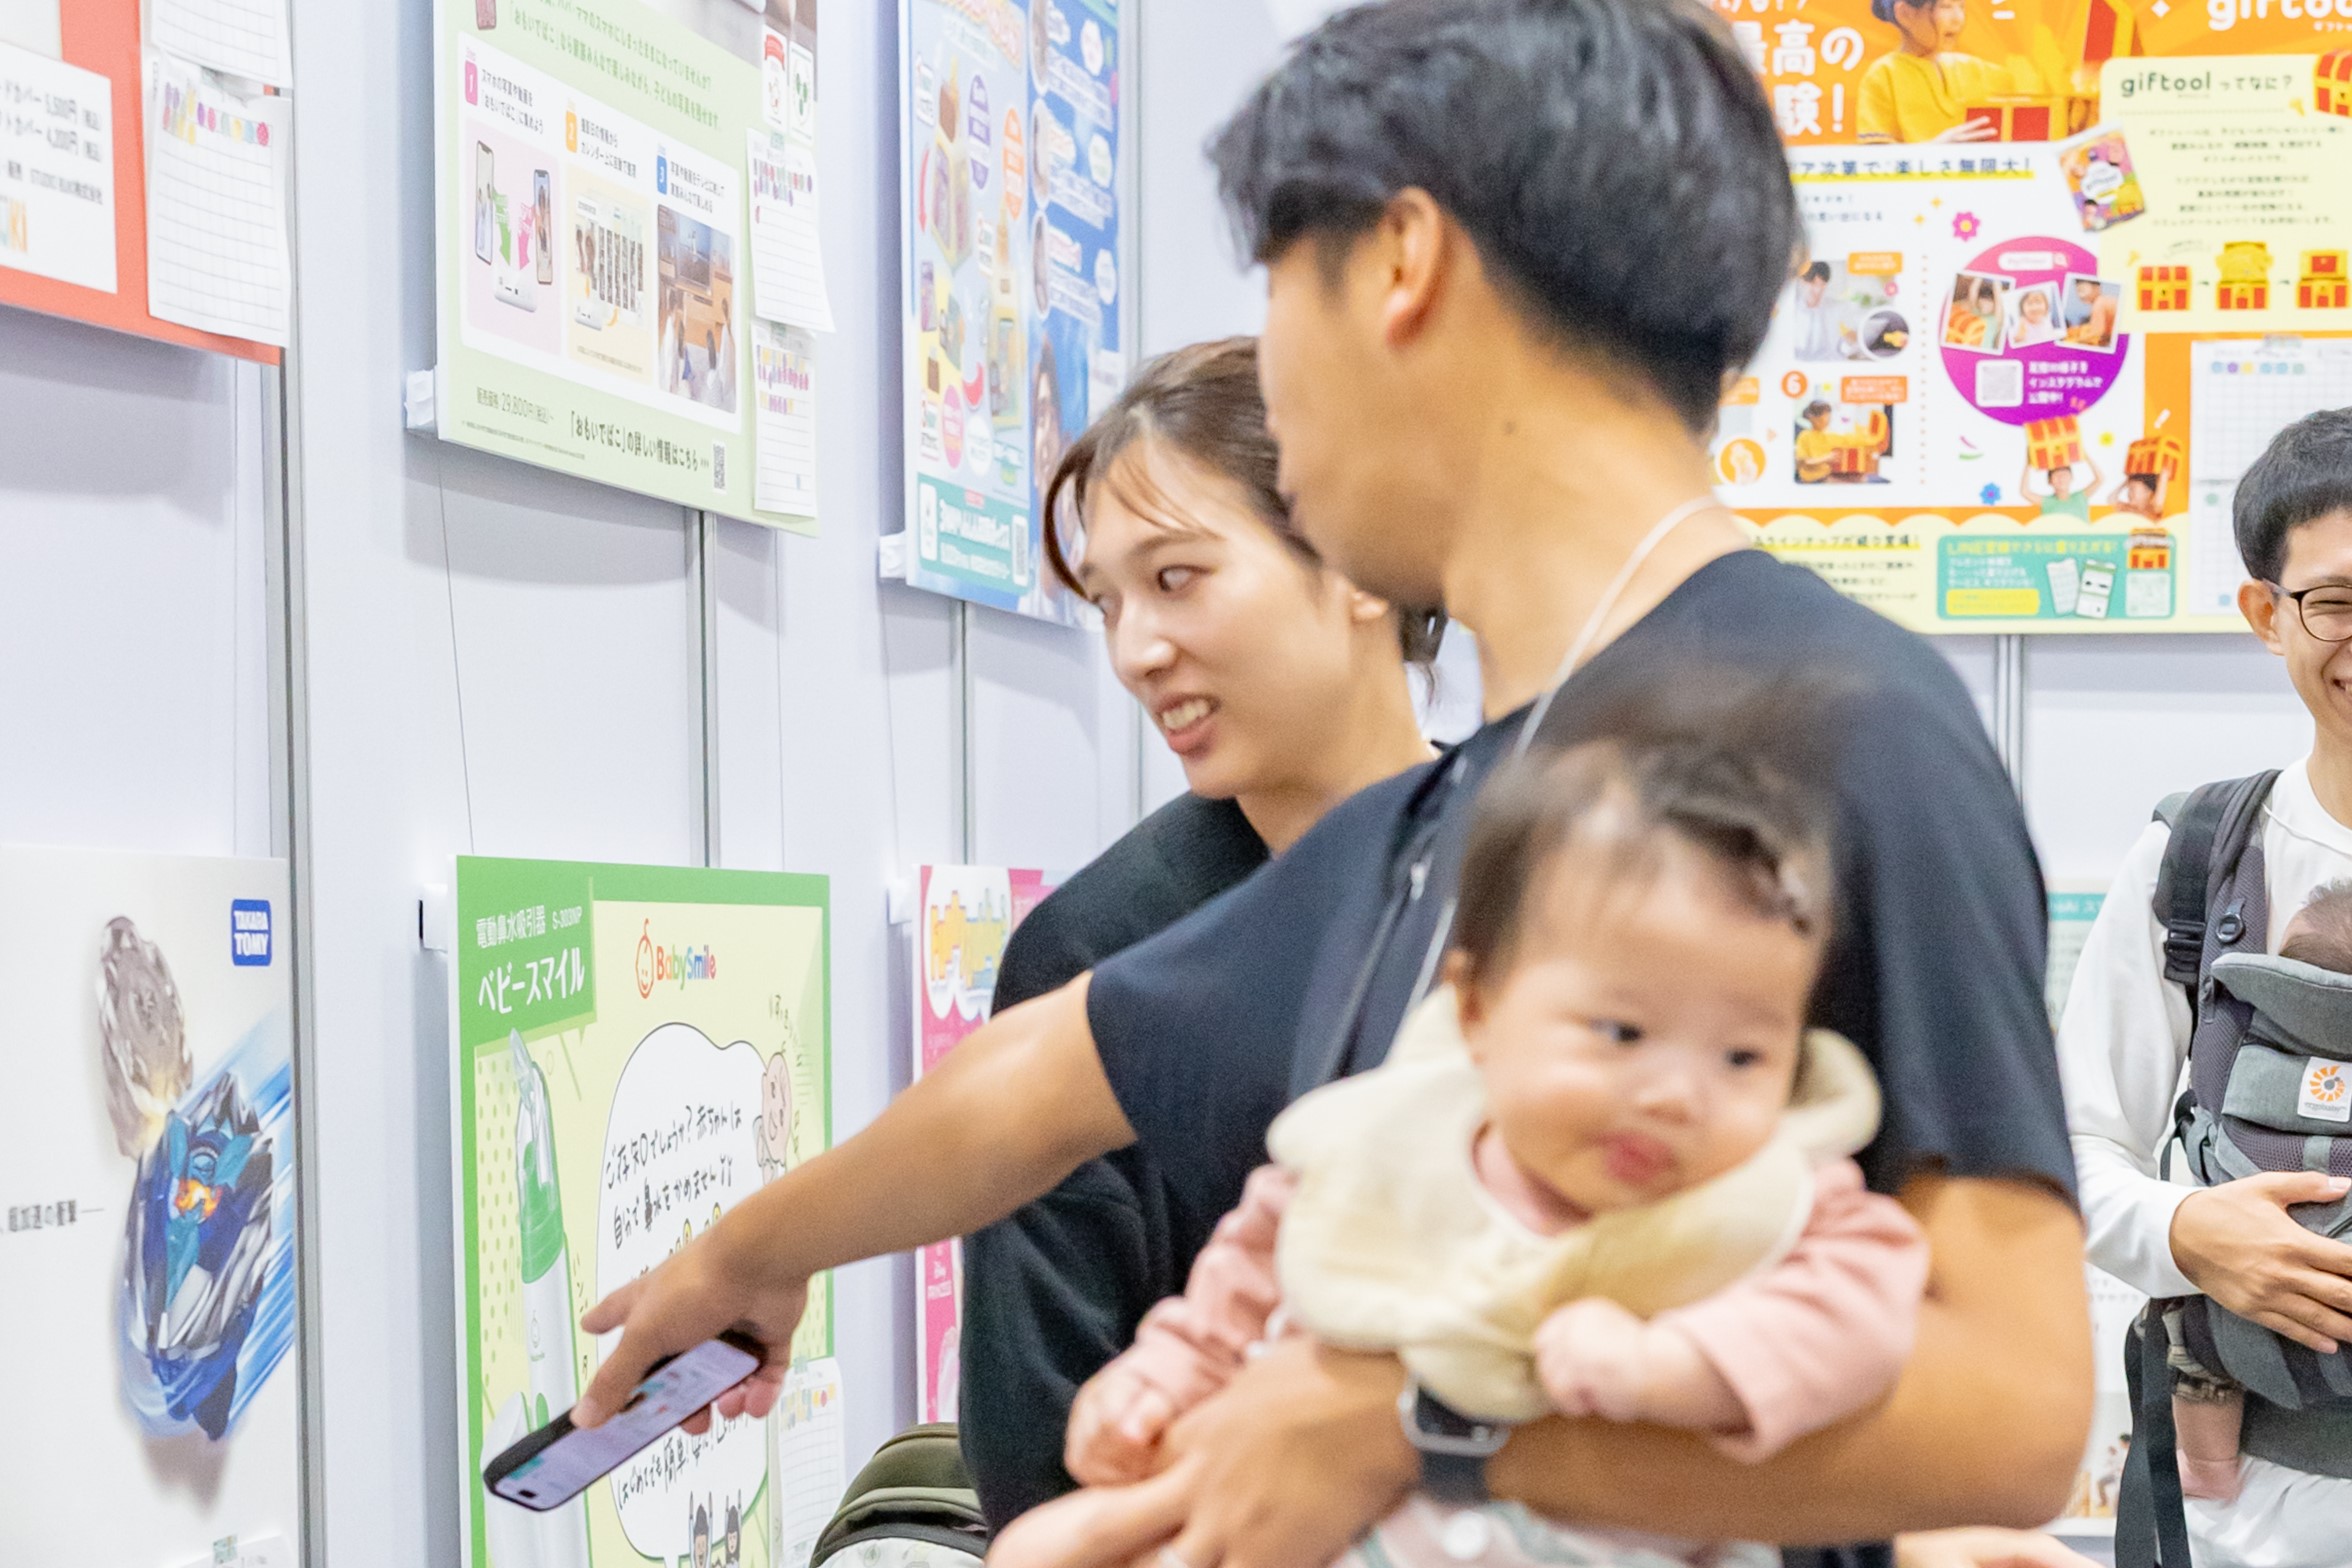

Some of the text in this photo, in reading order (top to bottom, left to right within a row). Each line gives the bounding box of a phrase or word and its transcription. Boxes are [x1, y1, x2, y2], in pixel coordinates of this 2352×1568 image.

[2121, 70, 2211, 98] giftool
[1787, 374, 1803, 396] 6
[233, 933, 269, 956] TOMY
[476, 904, 546, 949] 電動鼻水吸引器
[477, 946, 586, 1015] ベビースマイル
[656, 945, 717, 991] BabySmile
